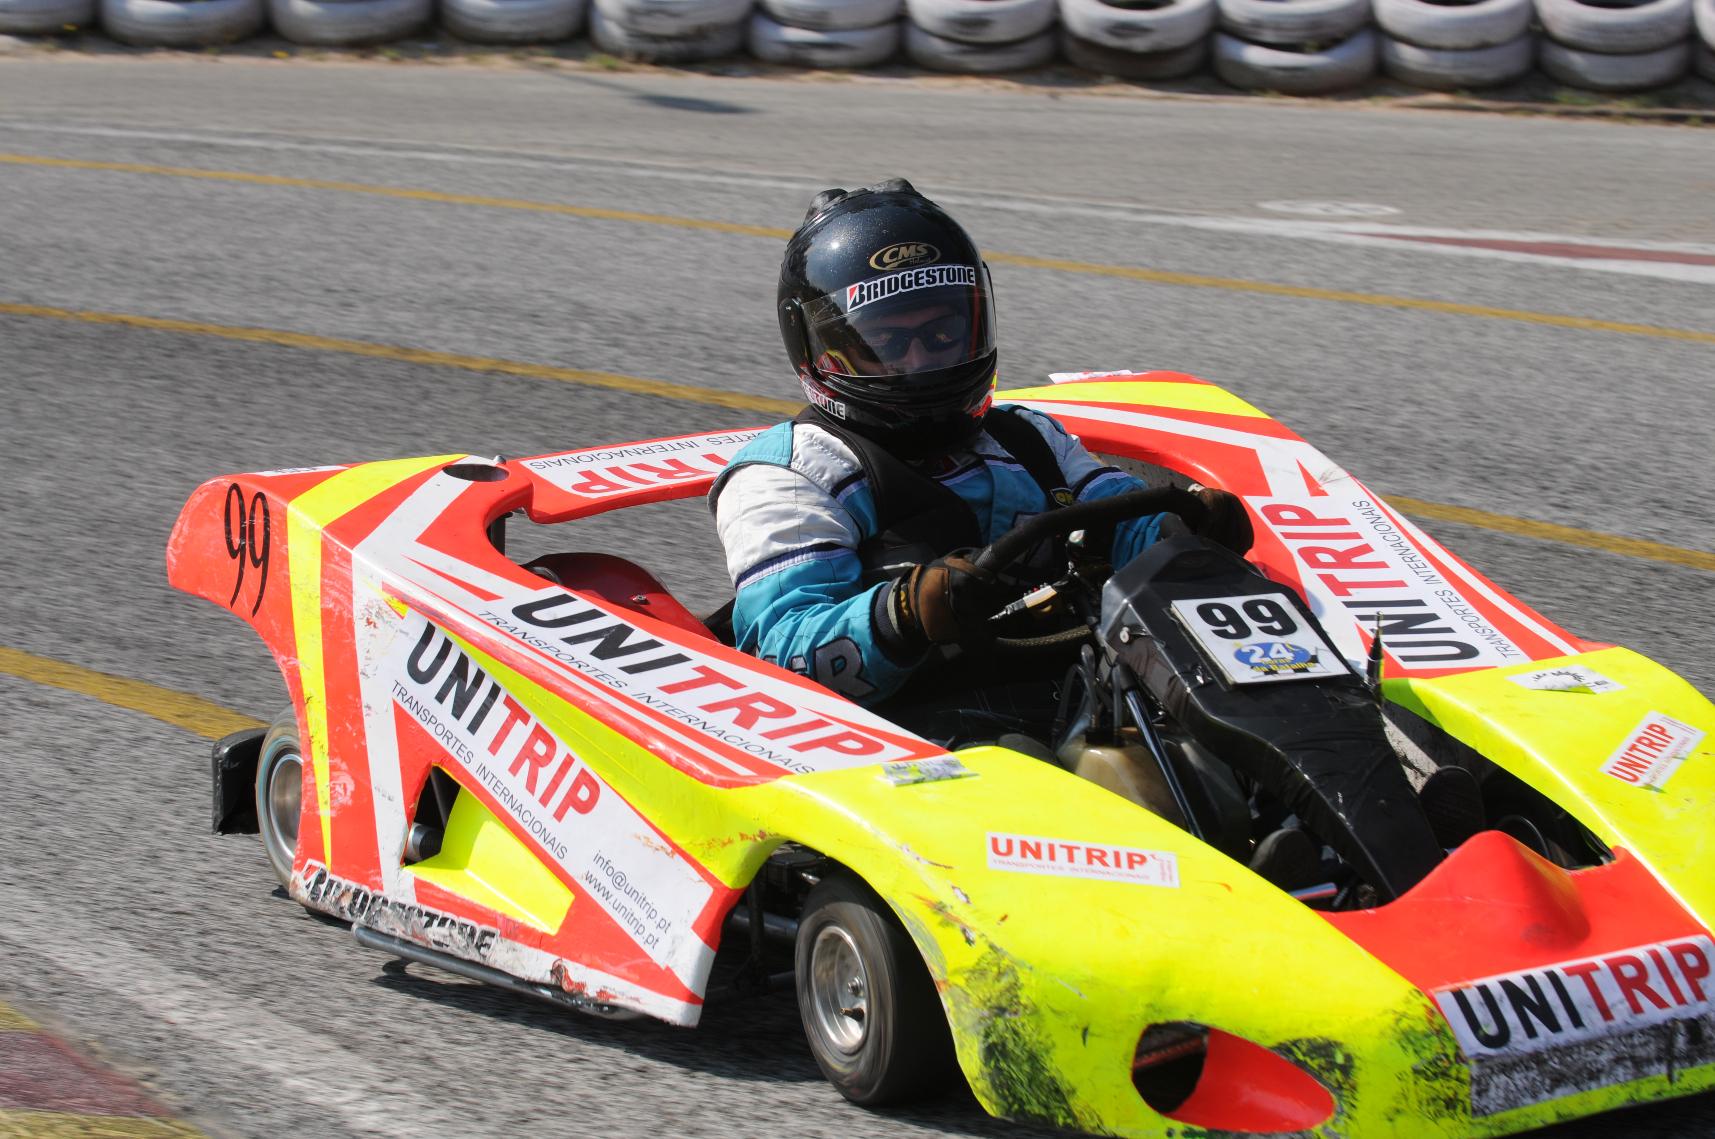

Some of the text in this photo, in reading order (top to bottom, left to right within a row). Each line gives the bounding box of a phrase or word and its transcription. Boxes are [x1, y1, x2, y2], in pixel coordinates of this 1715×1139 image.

[848, 266, 975, 310] BRIDGESTONE
[882, 243, 929, 263] CMS
[530, 429, 762, 470] RTES INTERNACIONAIS
[224, 482, 270, 618] 99
[1261, 503, 1480, 664] UNITRIP
[1352, 499, 1520, 659] TRANSPORTES INTERNACIONAIS
[1196, 598, 1298, 640] 99
[1241, 642, 1295, 664] 24
[478, 610, 815, 775] TRANSPORTES INTERNACIONAIS
[511, 593, 885, 760] UNITRIP
[406, 620, 601, 824] UNITRIP
[1607, 723, 1675, 783] UNITRIP
[392, 680, 568, 860] TRANSPORTES INTERNACIONAIS
[593, 850, 671, 935] info@unitrip.pt
[990, 836, 1148, 870] UNITRIP
[585, 869, 660, 950] www.unitrip.pt
[1451, 942, 1711, 1050] UNITRIP
